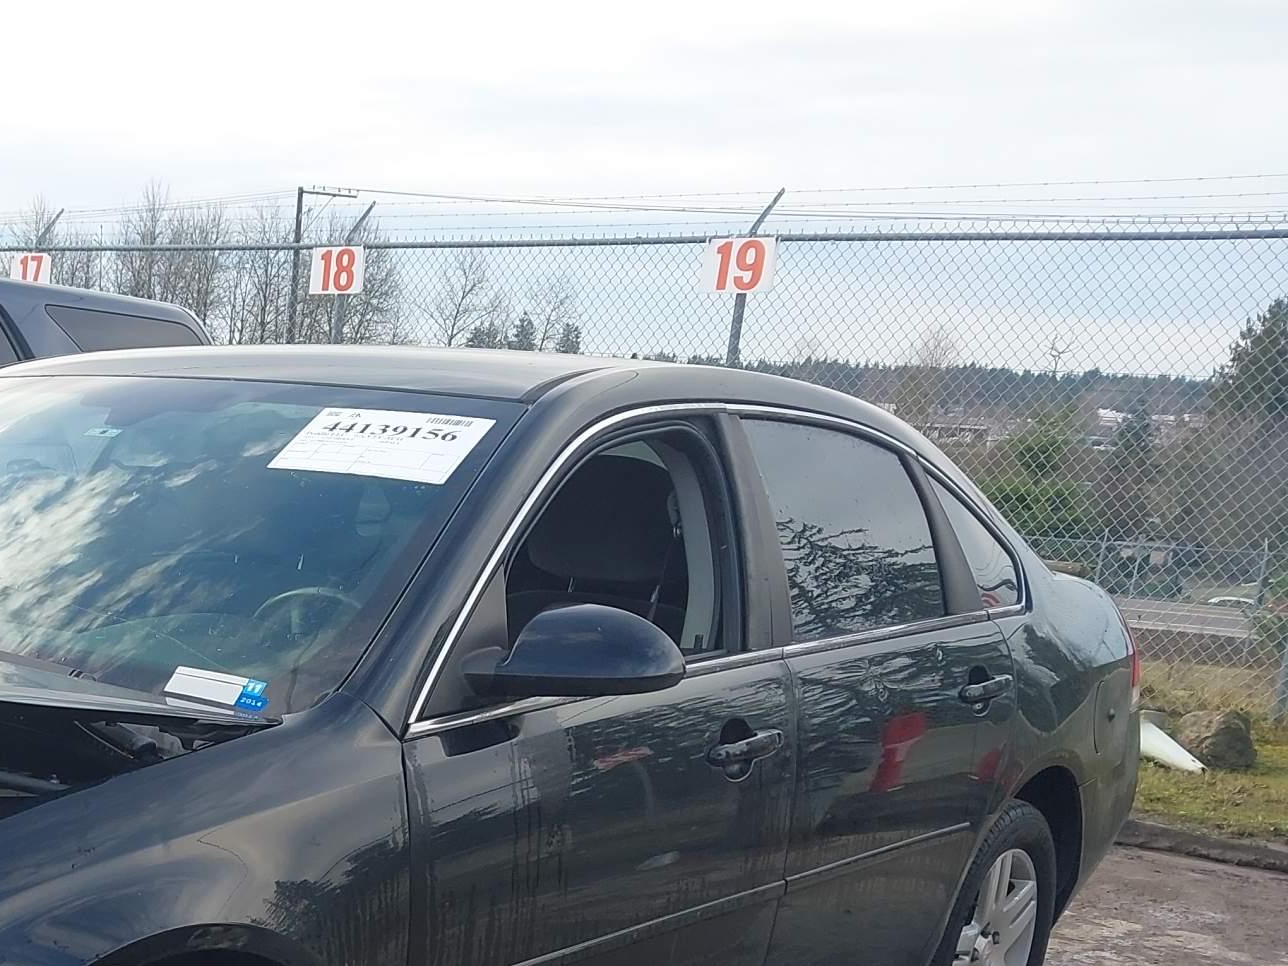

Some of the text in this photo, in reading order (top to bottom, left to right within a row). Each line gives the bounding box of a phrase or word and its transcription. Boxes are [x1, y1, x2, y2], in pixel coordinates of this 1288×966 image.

[19, 255, 44, 282] 17
[321, 248, 355, 291] 18
[716, 239, 766, 291] 19
[322, 420, 461, 442] 44139156
[247, 682, 263, 694] 11
[240, 697, 263, 707] 2014
